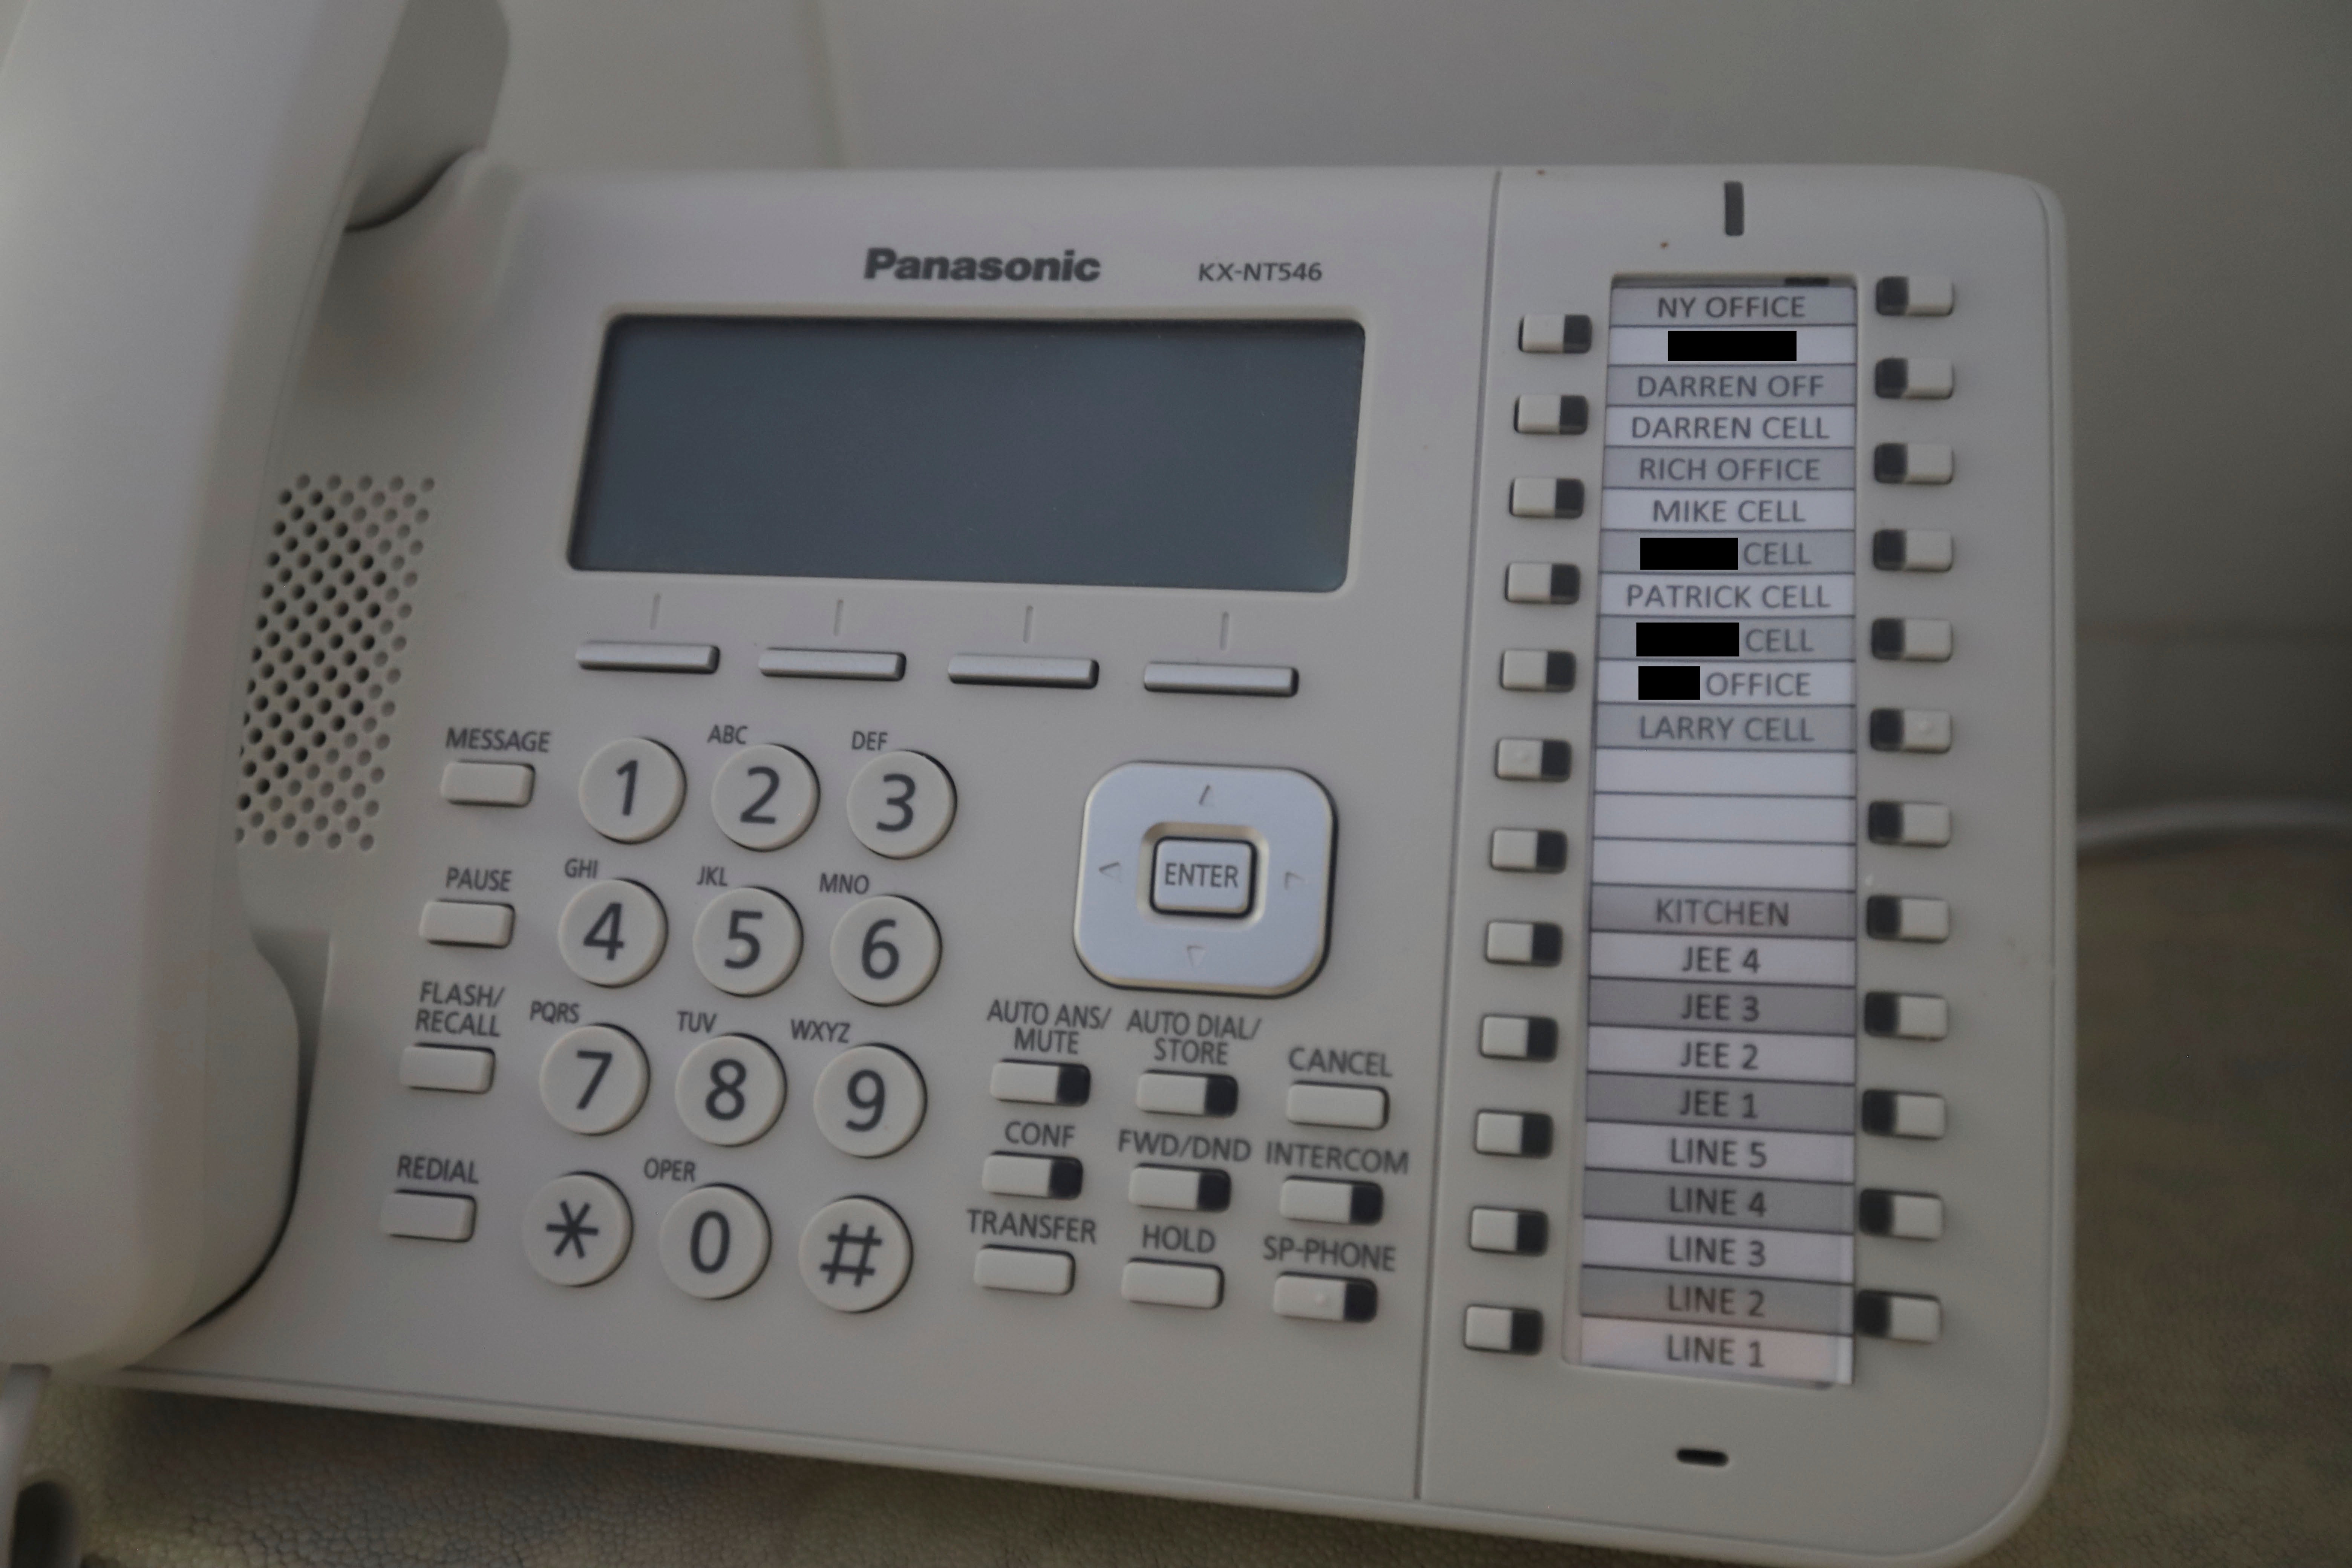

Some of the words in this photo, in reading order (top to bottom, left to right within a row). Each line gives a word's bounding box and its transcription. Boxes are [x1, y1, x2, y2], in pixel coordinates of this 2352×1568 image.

[863, 247, 1100, 281] Panasonic
[1199, 262, 1322, 281] KX-NT546
[1658, 297, 1695, 317] NY
[1706, 297, 1805, 317] OFFICE
[1638, 377, 1756, 397] DARREN
[1769, 377, 1824, 397] OFF
[1632, 417, 1751, 439] DARREN
[1762, 418, 1830, 439] CELL
[1640, 459, 1706, 481] RICH
[1718, 459, 1820, 481] OFFICE
[1654, 500, 1726, 522] MIKE
[1738, 501, 1805, 522] CELL
[1743, 543, 1811, 565] CELL
[1627, 585, 1751, 607] PATRICK
[1762, 585, 1831, 608] CELL
[1746, 629, 1813, 652] CELL
[1706, 673, 1811, 697] OFFICE
[446, 727, 550, 753] MESSAGE
[708, 726, 748, 745] ABC
[851, 732, 887, 750] DEF
[1640, 717, 1733, 740] LARRY
[1745, 718, 1814, 742] CELL
[616, 761, 638, 815] 1
[740, 767, 779, 824] 2
[877, 773, 916, 831] 3
[446, 868, 512, 892] PAUSE
[565, 860, 597, 879] GHI
[697, 866, 727, 887] JKL
[1165, 863, 1239, 888] ENTER
[819, 874, 870, 895] MNO
[1657, 899, 1789, 926] KITCHEN
[584, 903, 624, 960] 4
[724, 911, 763, 969] 5
[862, 919, 899, 979] 6
[1682, 947, 1730, 973] JEE
[1743, 949, 1760, 974] 4
[421, 982, 505, 1008] FLASH/
[1681, 995, 1730, 1021] JEE
[1743, 997, 1759, 1021] 3
[416, 1011, 500, 1037] RECALL
[530, 1001, 580, 1024] PQRS
[678, 1011, 717, 1033] TUV
[988, 1000, 1048, 1024] AUTO
[1055, 1006, 1112, 1030] ANS/
[1127, 1011, 1191, 1036] AUTO
[1197, 1015, 1261, 1040] DIAL/
[791, 1020, 850, 1043] WXYZ
[1014, 1029, 1079, 1053] MUTE
[1155, 1040, 1228, 1065] STORE
[1289, 1047, 1392, 1078] CANCEL
[1680, 1043, 1729, 1070] JEE
[1742, 1045, 1758, 1070] 2
[576, 1052, 612, 1110] 7
[706, 1059, 746, 1120] 8
[846, 1069, 885, 1130] 9
[1680, 1091, 1729, 1118] JEE
[1742, 1093, 1758, 1119] 1
[1005, 1122, 1075, 1148] CONF
[1119, 1131, 1251, 1161] FWD/DND
[1266, 1142, 1409, 1174] INTERCOM
[1671, 1139, 1736, 1166] LINE
[1750, 1142, 1766, 1167] 5
[397, 1156, 479, 1184] REDIAL
[644, 1158, 696, 1182] OPER
[1669, 1187, 1736, 1215] LINE
[1748, 1191, 1766, 1216] 4
[967, 1210, 1096, 1244] TRANSFER
[1142, 1226, 1215, 1253] HOLD
[690, 1211, 730, 1274] 0
[1263, 1236, 1395, 1272] SP-PHONE
[1669, 1235, 1736, 1264] LINE
[1749, 1241, 1766, 1266] 3
[1669, 1285, 1735, 1314] LINE
[1748, 1291, 1765, 1316] 2
[1668, 1335, 1735, 1365] LINE
[1749, 1342, 1764, 1367] 1
